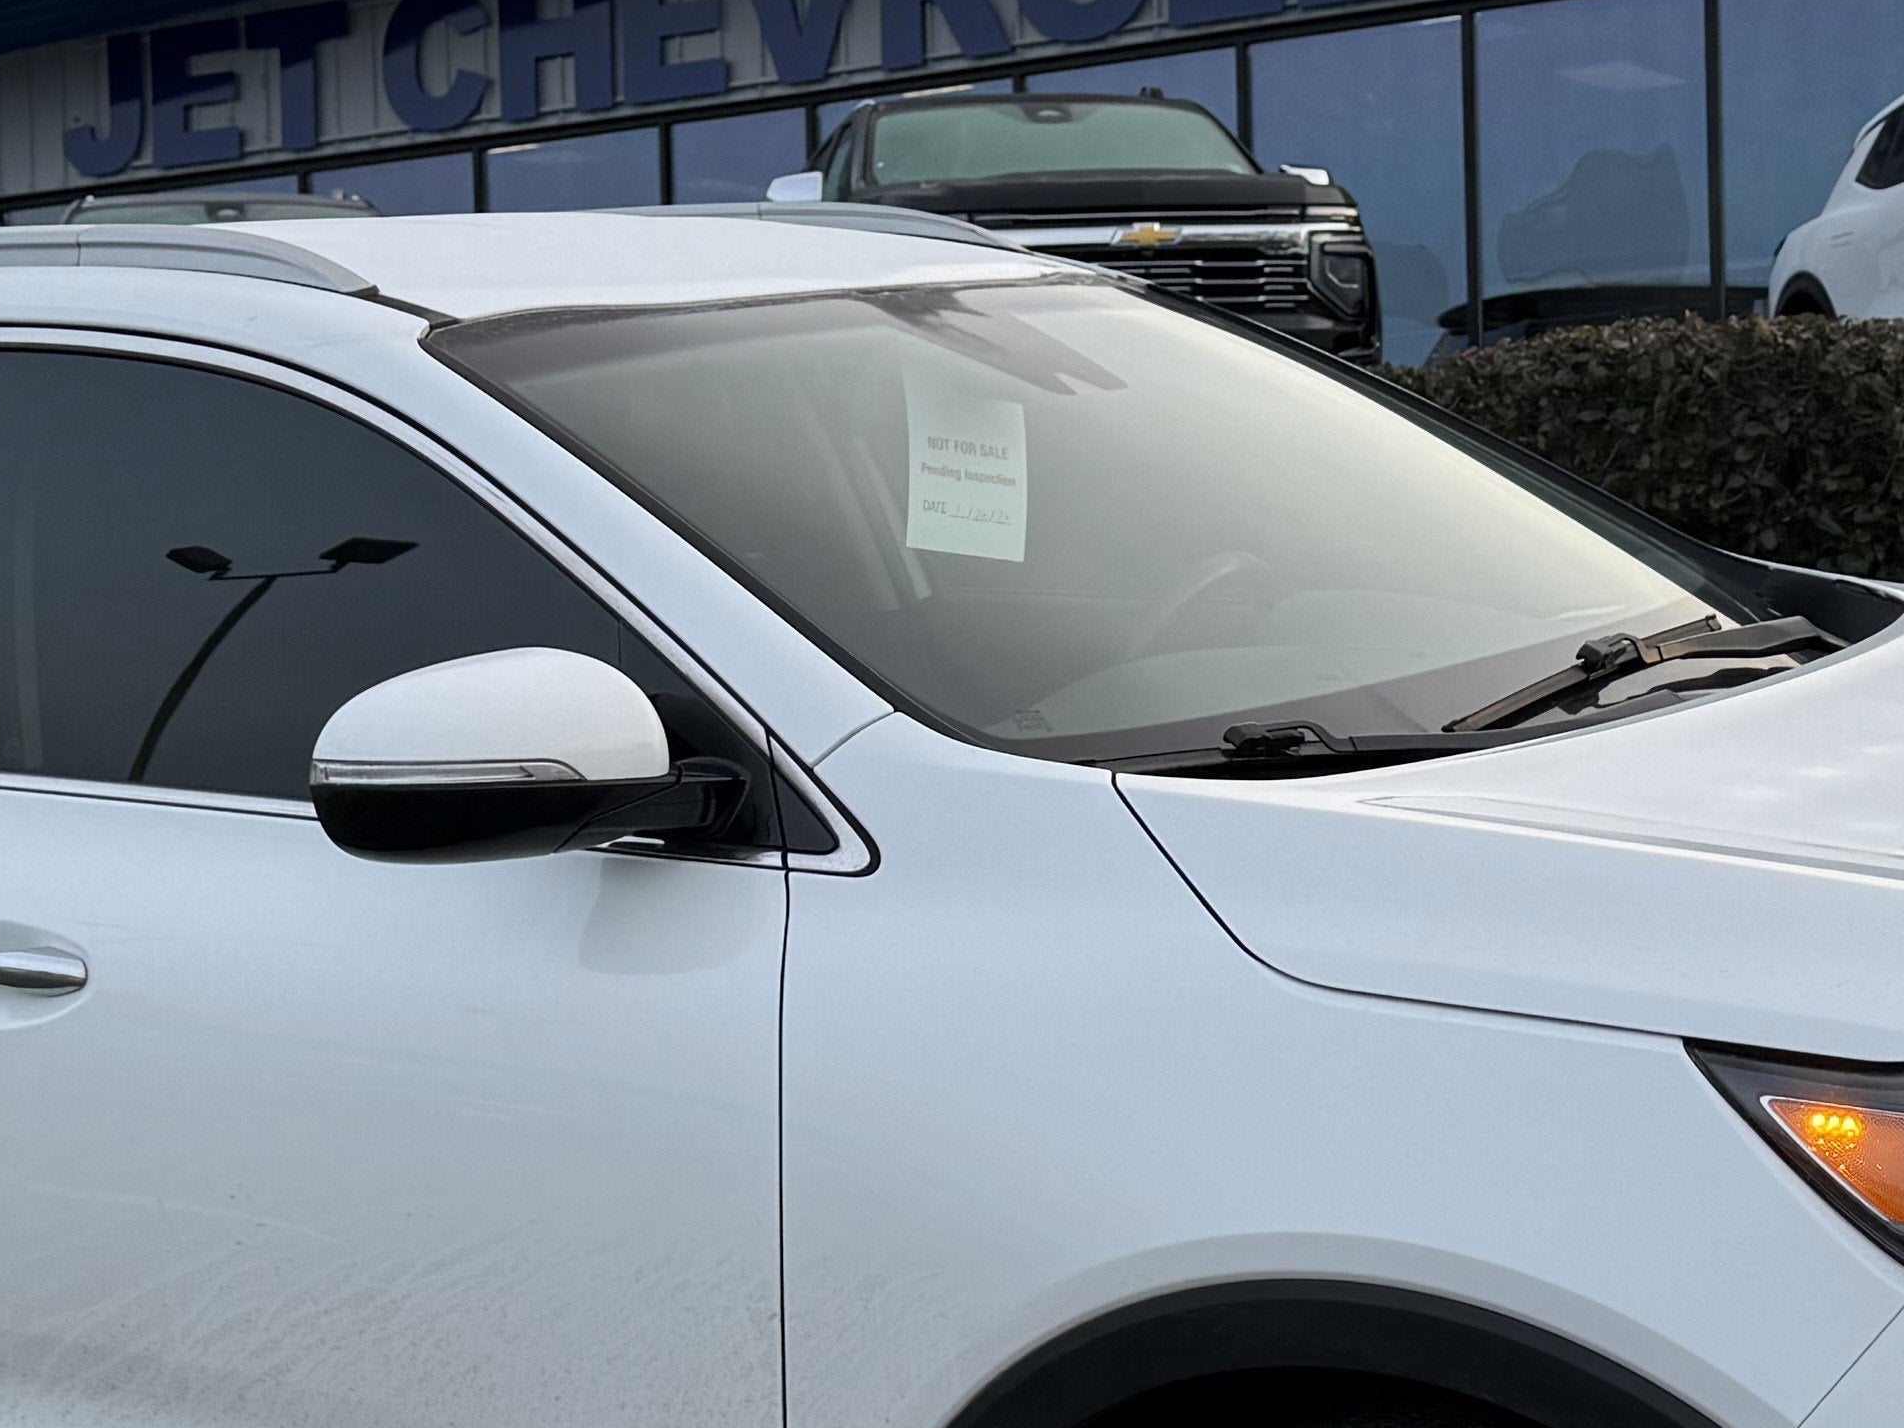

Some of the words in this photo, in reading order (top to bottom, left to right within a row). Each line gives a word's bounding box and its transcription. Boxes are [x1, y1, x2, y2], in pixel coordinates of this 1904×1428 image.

[63, 0, 349, 178] JET
[927, 435, 950, 452] NOT
[954, 439, 977, 456] FOR
[980, 443, 1009, 460] SALE
[921, 462, 962, 482] Pending
